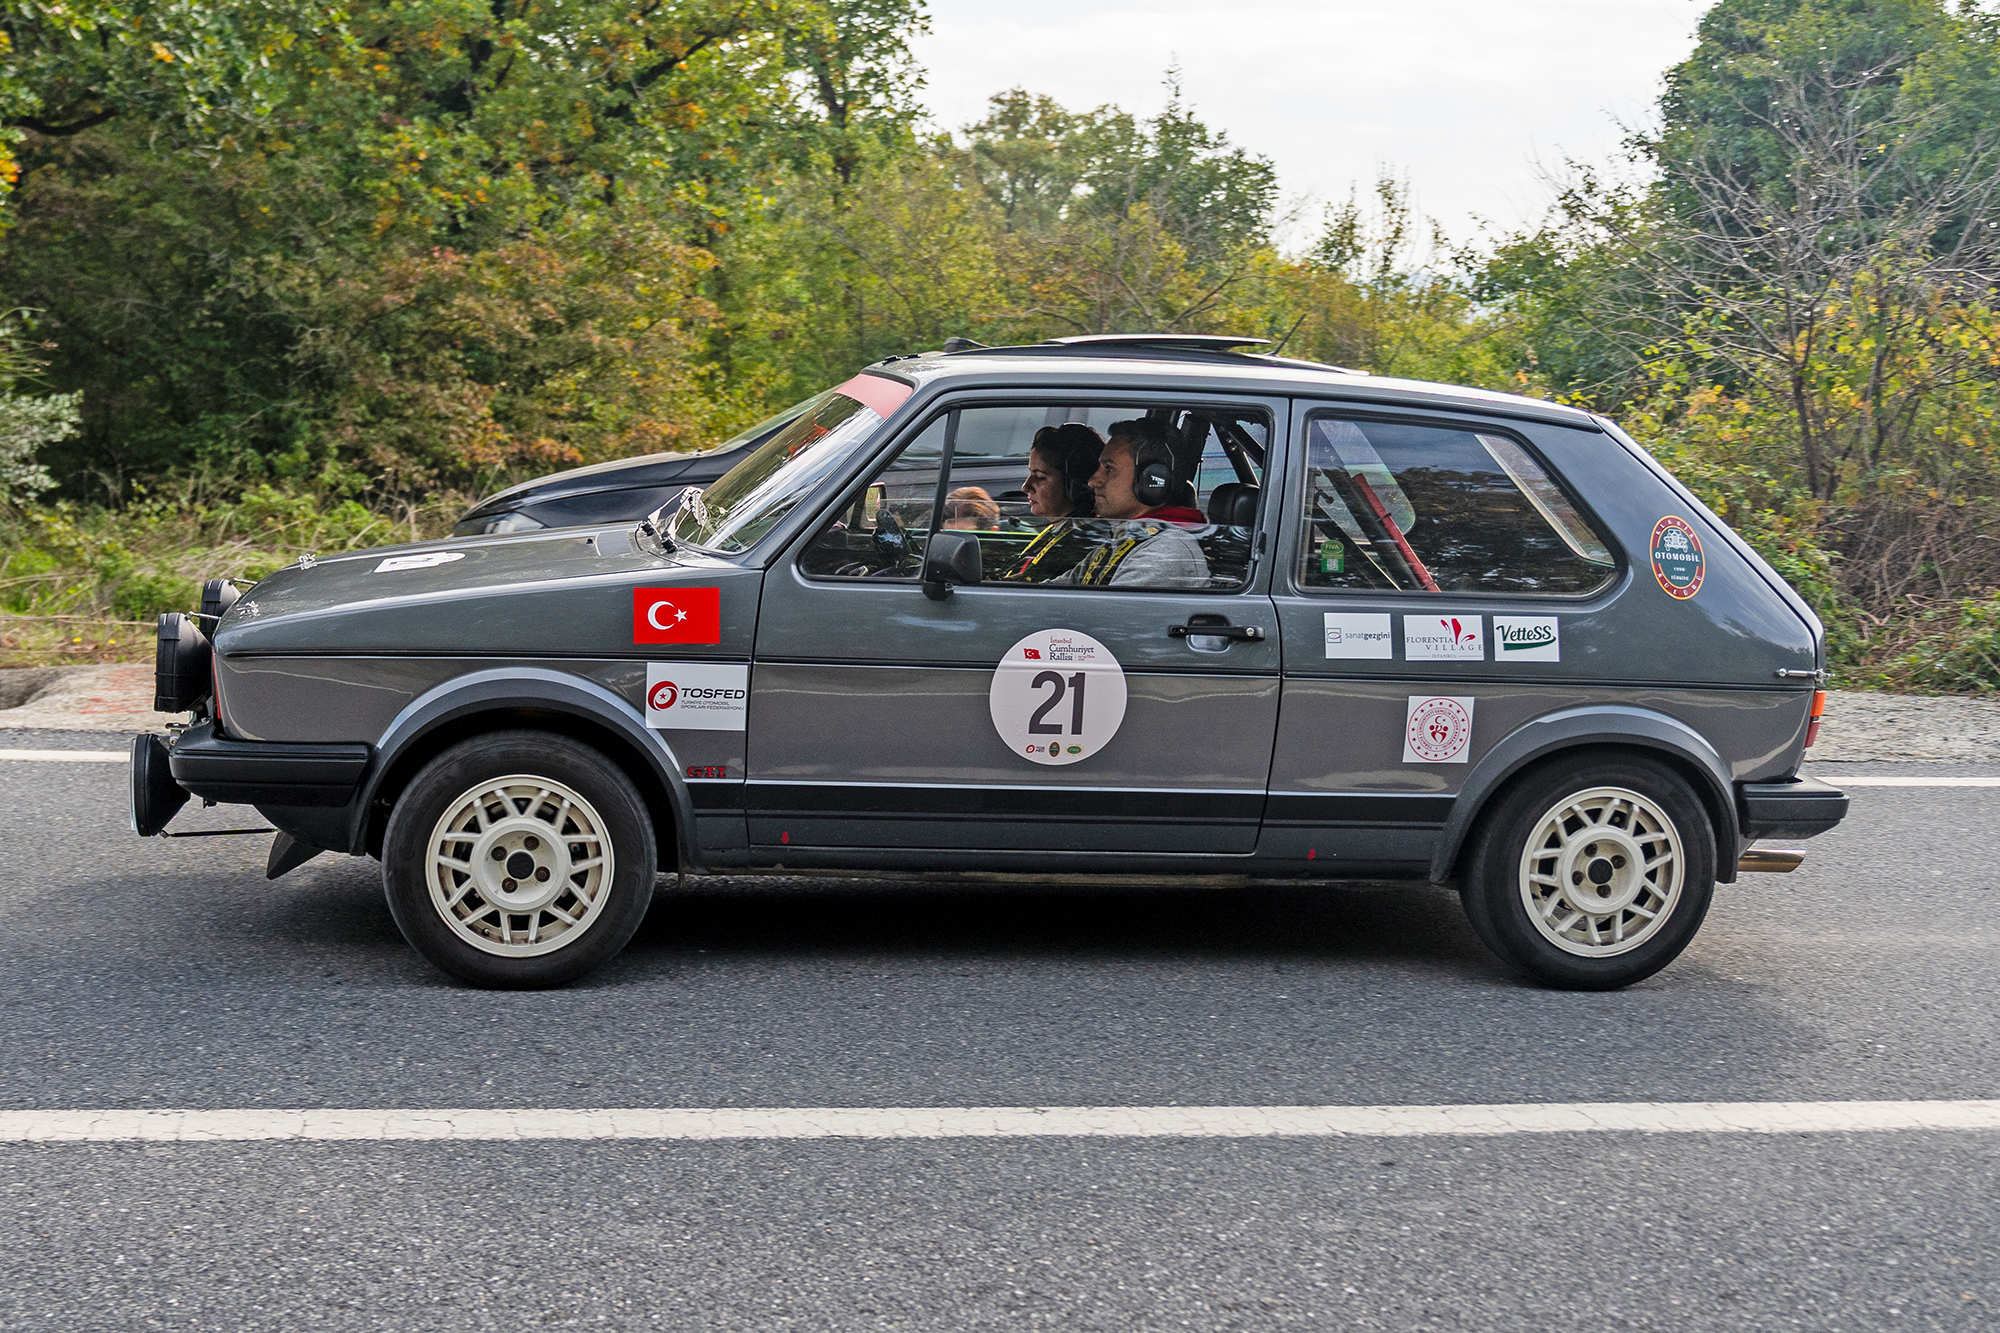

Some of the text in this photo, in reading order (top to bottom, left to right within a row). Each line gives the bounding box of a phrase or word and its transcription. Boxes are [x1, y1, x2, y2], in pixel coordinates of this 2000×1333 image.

[1655, 552, 1700, 562] OTOMOBİL
[1345, 631, 1391, 641] sanatgezgini
[1495, 625, 1552, 642] VetteSS
[1406, 636, 1454, 644] FLORENTIA
[1049, 643, 1095, 655] Cumhuriyet
[1049, 652, 1073, 661] Rallisi
[681, 688, 745, 699] TOSFED
[1028, 670, 1086, 735] 21
[687, 766, 727, 778] GTI
